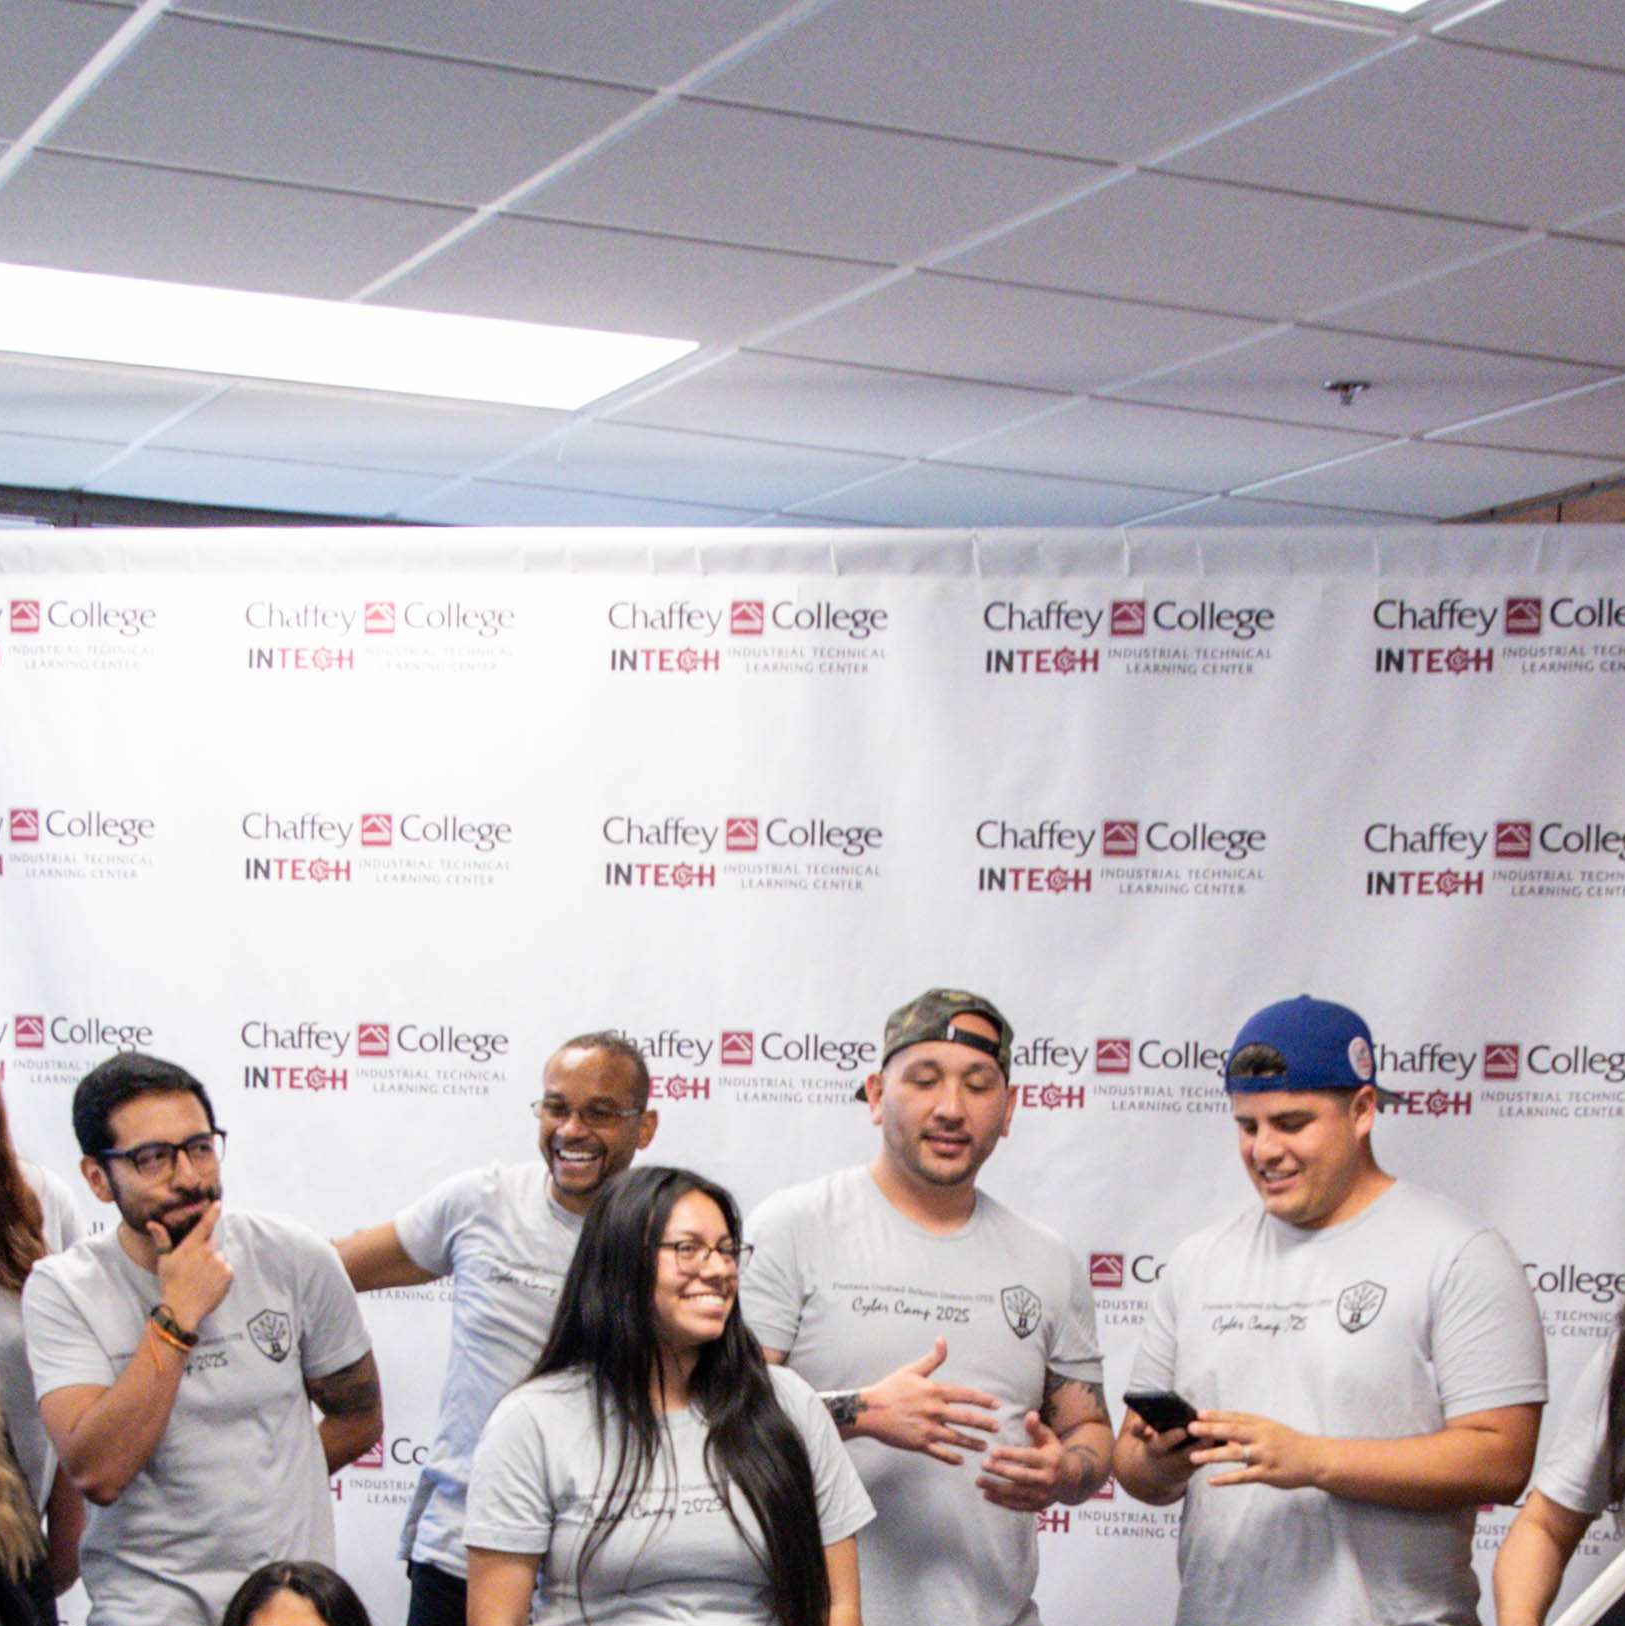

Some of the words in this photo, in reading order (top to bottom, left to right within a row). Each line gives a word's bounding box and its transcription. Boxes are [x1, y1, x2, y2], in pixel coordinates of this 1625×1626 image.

[46, 599, 158, 638] College
[245, 599, 358, 637] Chaffey
[402, 600, 518, 639] College
[607, 599, 724, 638] Chaffey
[770, 600, 890, 640] College
[983, 600, 1104, 638] Chaffey
[1152, 600, 1276, 640] College
[1373, 597, 1498, 638] Chaffey
[1107, 647, 1188, 659] INDUSTRIAL
[1194, 647, 1272, 659] TECHNICAL
[1501, 645, 1585, 658] INDUSTRIAL
[1126, 663, 1197, 675] LEARNING
[1202, 663, 1254, 675] CENTER
[1521, 661, 1595, 674] LEARNING
[45, 808, 156, 848] College
[241, 810, 354, 849] Chaffey
[399, 812, 514, 853] College
[603, 814, 719, 853] Chaffey
[765, 816, 884, 857] College
[976, 818, 1096, 858] Chaffey
[1145, 820, 1267, 861] College
[1365, 821, 1488, 860] Chaffey
[722, 862, 800, 875] INDUSTRIAL
[806, 863, 881, 876] TECHNICAL
[1100, 866, 1180, 879] INDUSTRIAL
[1186, 867, 1264, 880] TECHNICAL
[1491, 869, 1573, 881] INDUSTRIAL
[740, 878, 809, 891] LEARNING
[813, 879, 864, 891] CENTER
[1118, 883, 1189, 895] LEARNING
[1194, 884, 1246, 896] CENTER
[1509, 885, 1582, 897] LEARNING
[50, 1016, 153, 1052] College
[240, 1019, 352, 1058] Chaffey
[396, 1023, 510, 1064] College
[759, 1031, 877, 1072] College
[1012, 1035, 1090, 1075] affey
[1377, 1039, 1478, 1080] haffey
[355, 1066, 430, 1080] INDUSTRIAL
[435, 1068, 507, 1082] TECHNICAL
[372, 1082, 438, 1095] LEARNING
[442, 1084, 491, 1096] CENTER
[716, 1075, 793, 1089] INDUSTRIAL
[1092, 1083, 1172, 1097] INDUSTRIAL
[1479, 1089, 1562, 1103] INDUSTRIAL
[733, 1091, 801, 1104] LEARNING
[1110, 1100, 1180, 1113] LEARNING
[1498, 1106, 1571, 1119] LEARNING
[851, 1297, 889, 1318] Cyber
[894, 1300, 932, 1320] Camp
[935, 1305, 970, 1324] 2025
[197, 1351, 228, 1369] 2025
[1072, 1506, 1142, 1517] INDUSTRIAL
[1088, 1518, 1149, 1530] LEARNING
